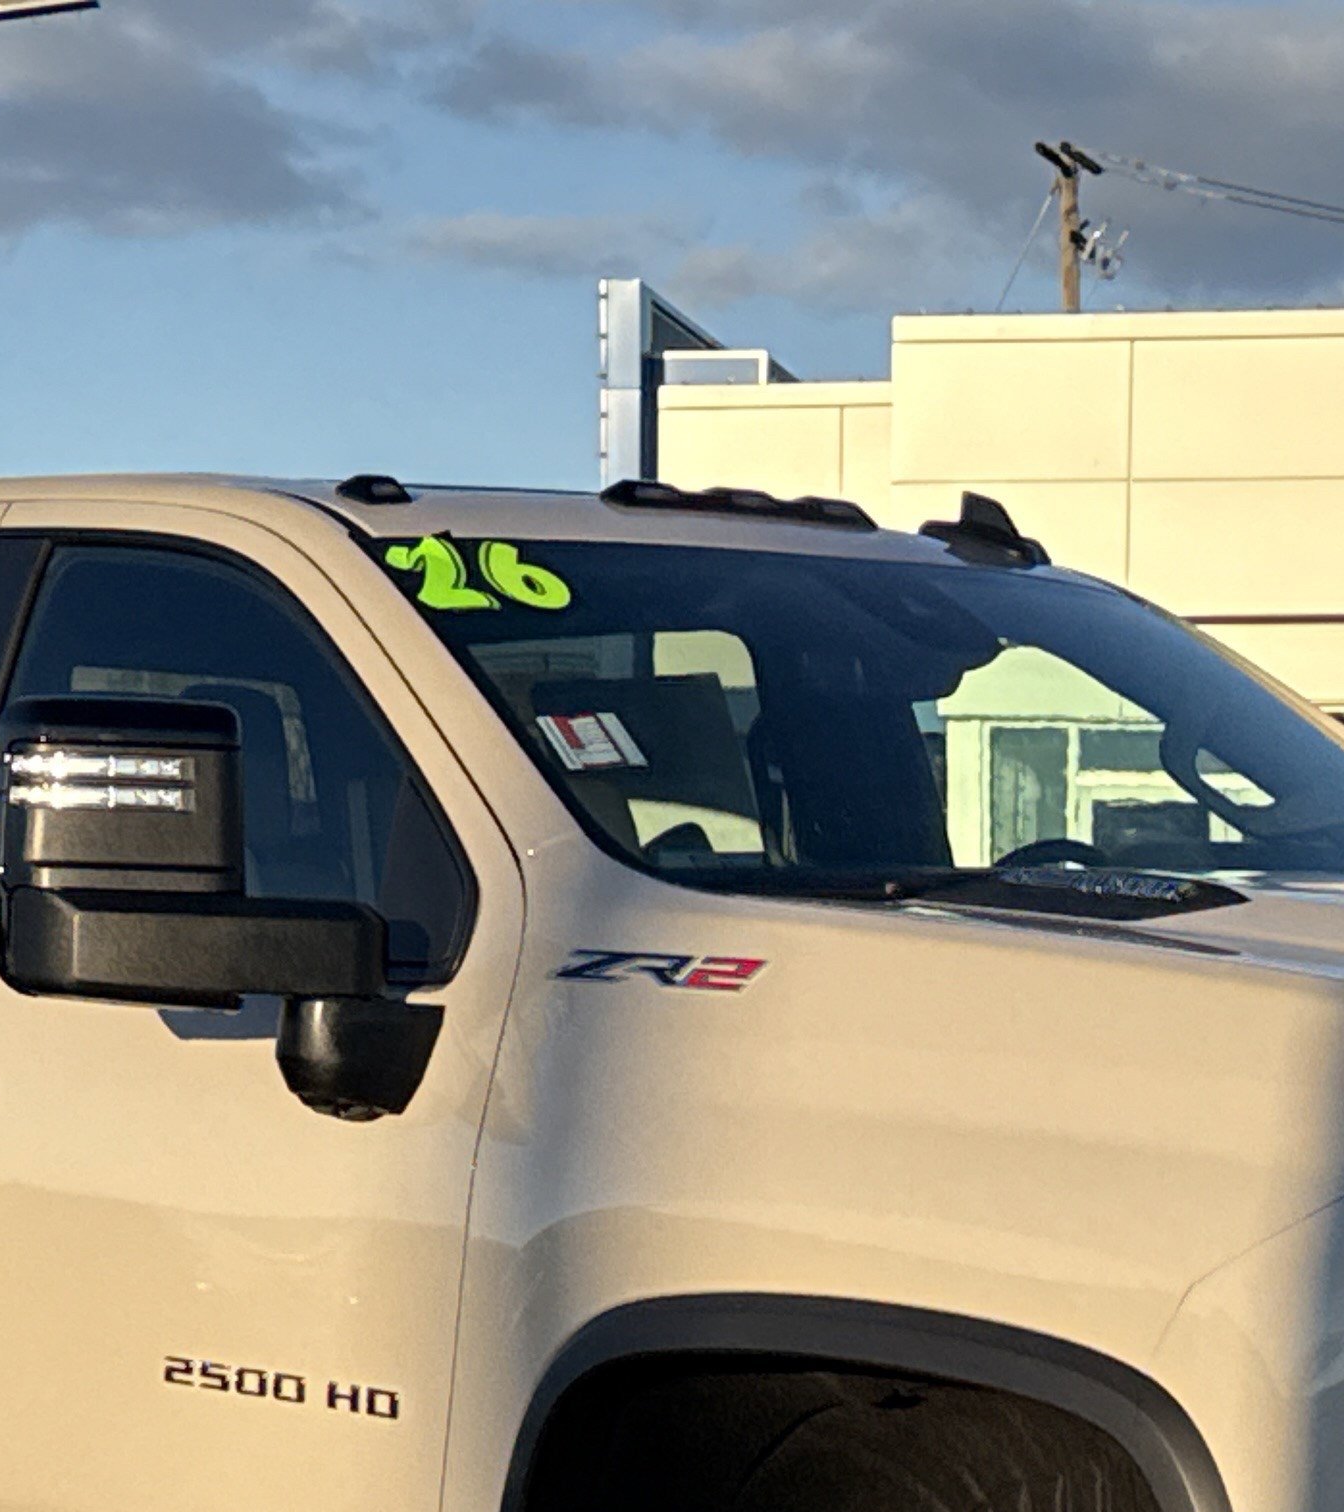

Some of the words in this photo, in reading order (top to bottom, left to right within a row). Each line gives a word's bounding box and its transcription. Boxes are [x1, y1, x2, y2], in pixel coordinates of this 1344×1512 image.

[555, 949, 767, 991] ZR2
[163, 1355, 306, 1404] 2500
[326, 1380, 400, 1420] HD
